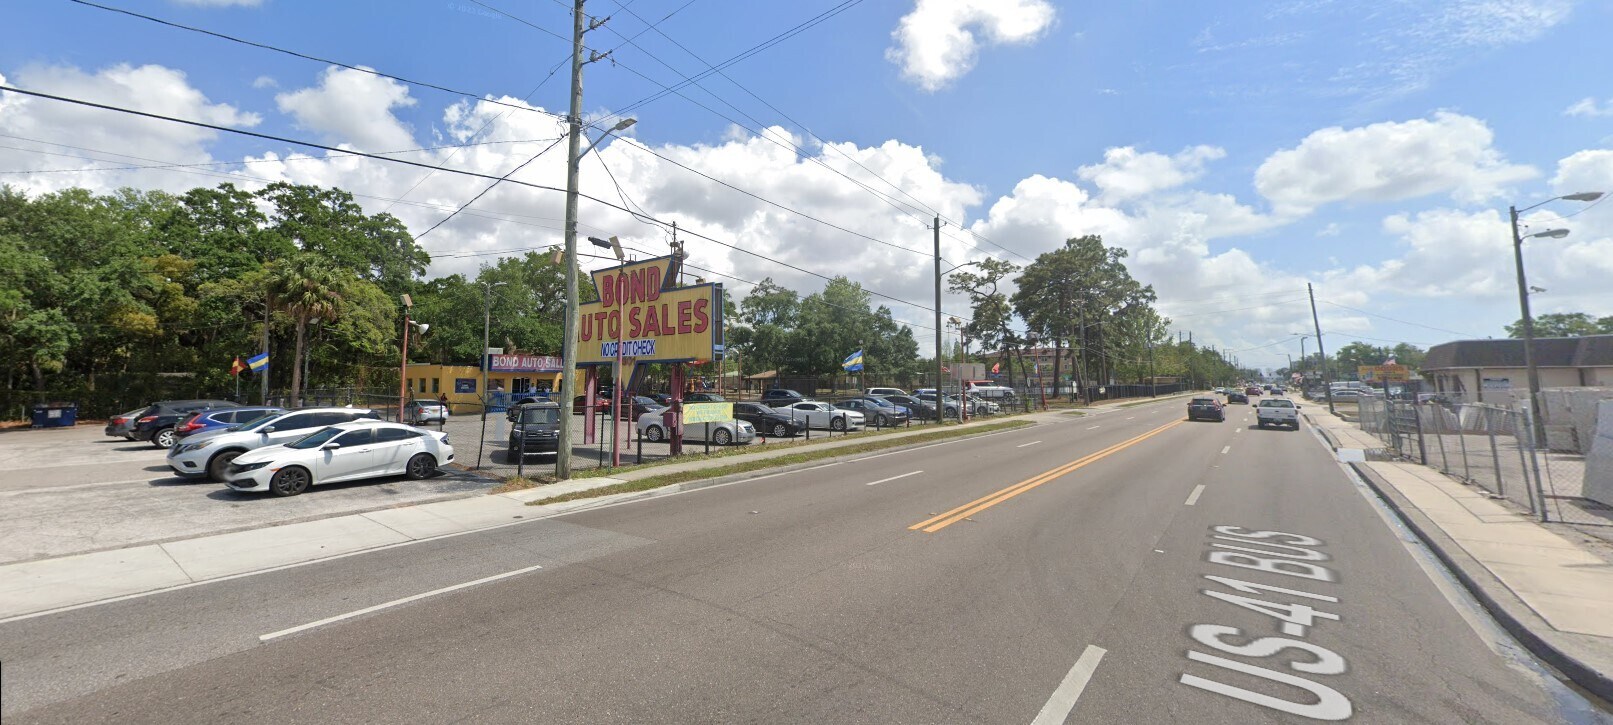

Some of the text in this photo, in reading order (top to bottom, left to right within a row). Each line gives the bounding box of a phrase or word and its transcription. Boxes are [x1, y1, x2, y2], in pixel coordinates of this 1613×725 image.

[602, 266, 661, 308] BOND
[578, 299, 709, 342] UTO SALES
[492, 356, 519, 367] BOND
[521, 357, 543, 368] AUTO
[601, 339, 656, 357] NO CRDIT CHECK
[1179, 525, 1353, 721] US-41 BUS
